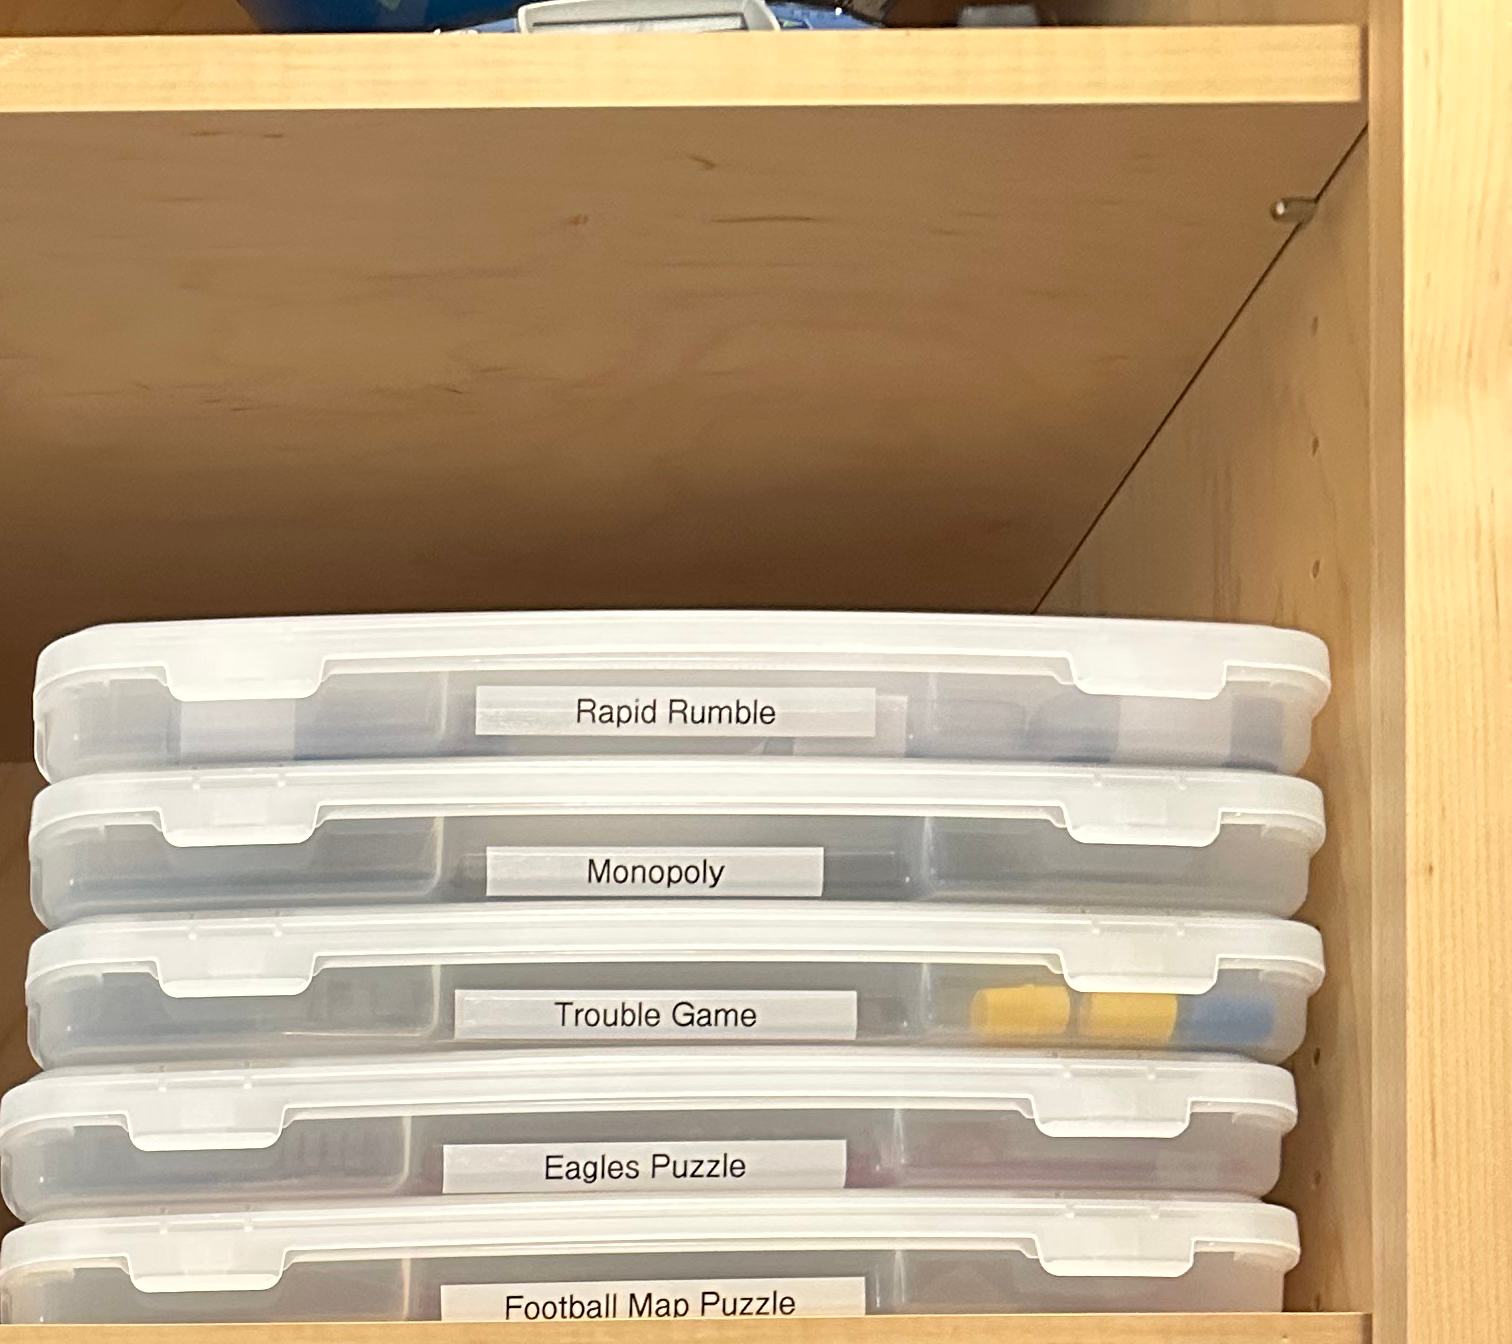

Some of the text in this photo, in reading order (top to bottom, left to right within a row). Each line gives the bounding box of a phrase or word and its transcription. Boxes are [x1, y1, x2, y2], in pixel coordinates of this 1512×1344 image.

[576, 697, 777, 728] Rapid Rumble
[586, 857, 726, 889] Monopoly
[553, 1000, 758, 1029] Trouble Game
[544, 1152, 747, 1184] Eagles Puzzle
[504, 1290, 797, 1320] Football Map Puzzle
